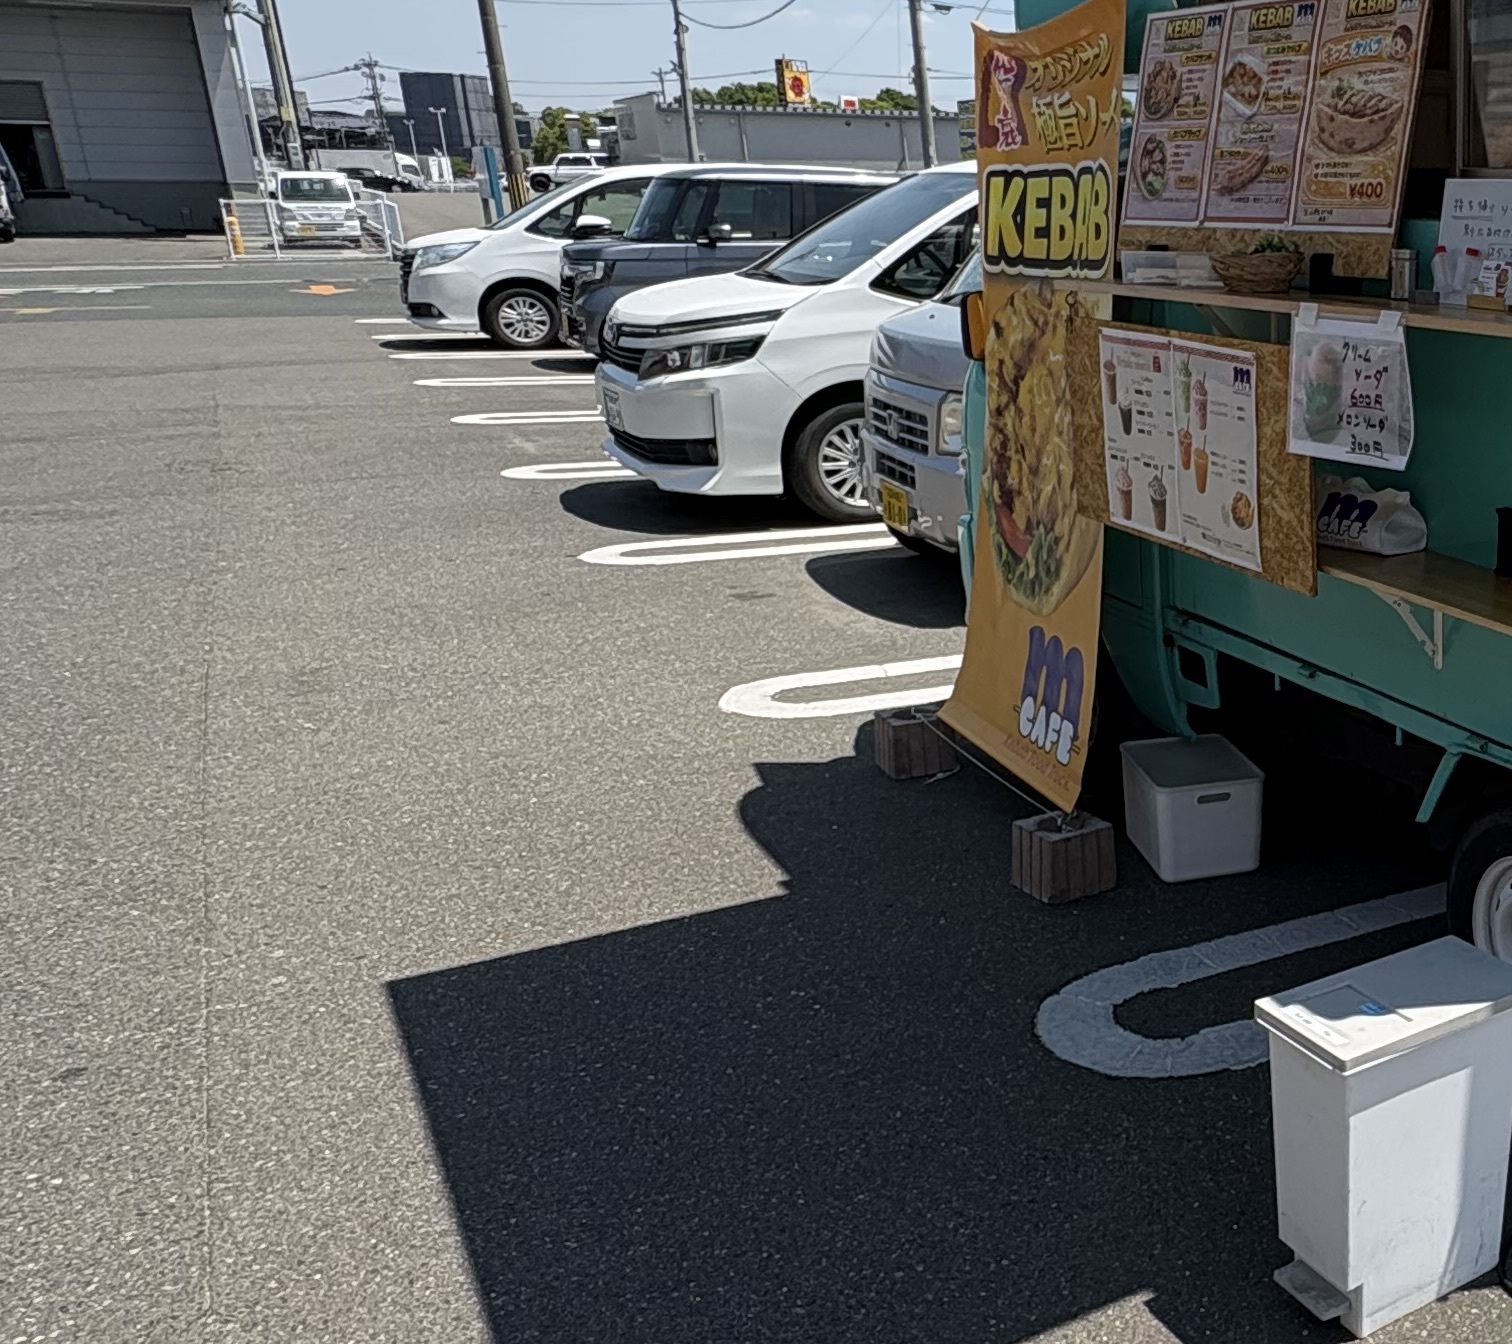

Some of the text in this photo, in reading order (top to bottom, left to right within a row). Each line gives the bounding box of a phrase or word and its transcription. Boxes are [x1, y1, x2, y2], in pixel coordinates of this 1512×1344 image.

[1165, 17, 1204, 41] KEBAB
[1250, 5, 1294, 32] KEBAB
[1027, 34, 1115, 92] オリジナル
[1348, 182, 1384, 199] ¥400
[985, 167, 1109, 264] KEBAB
[1317, 515, 1363, 539] CAFE
[1017, 694, 1077, 767] CAFE
